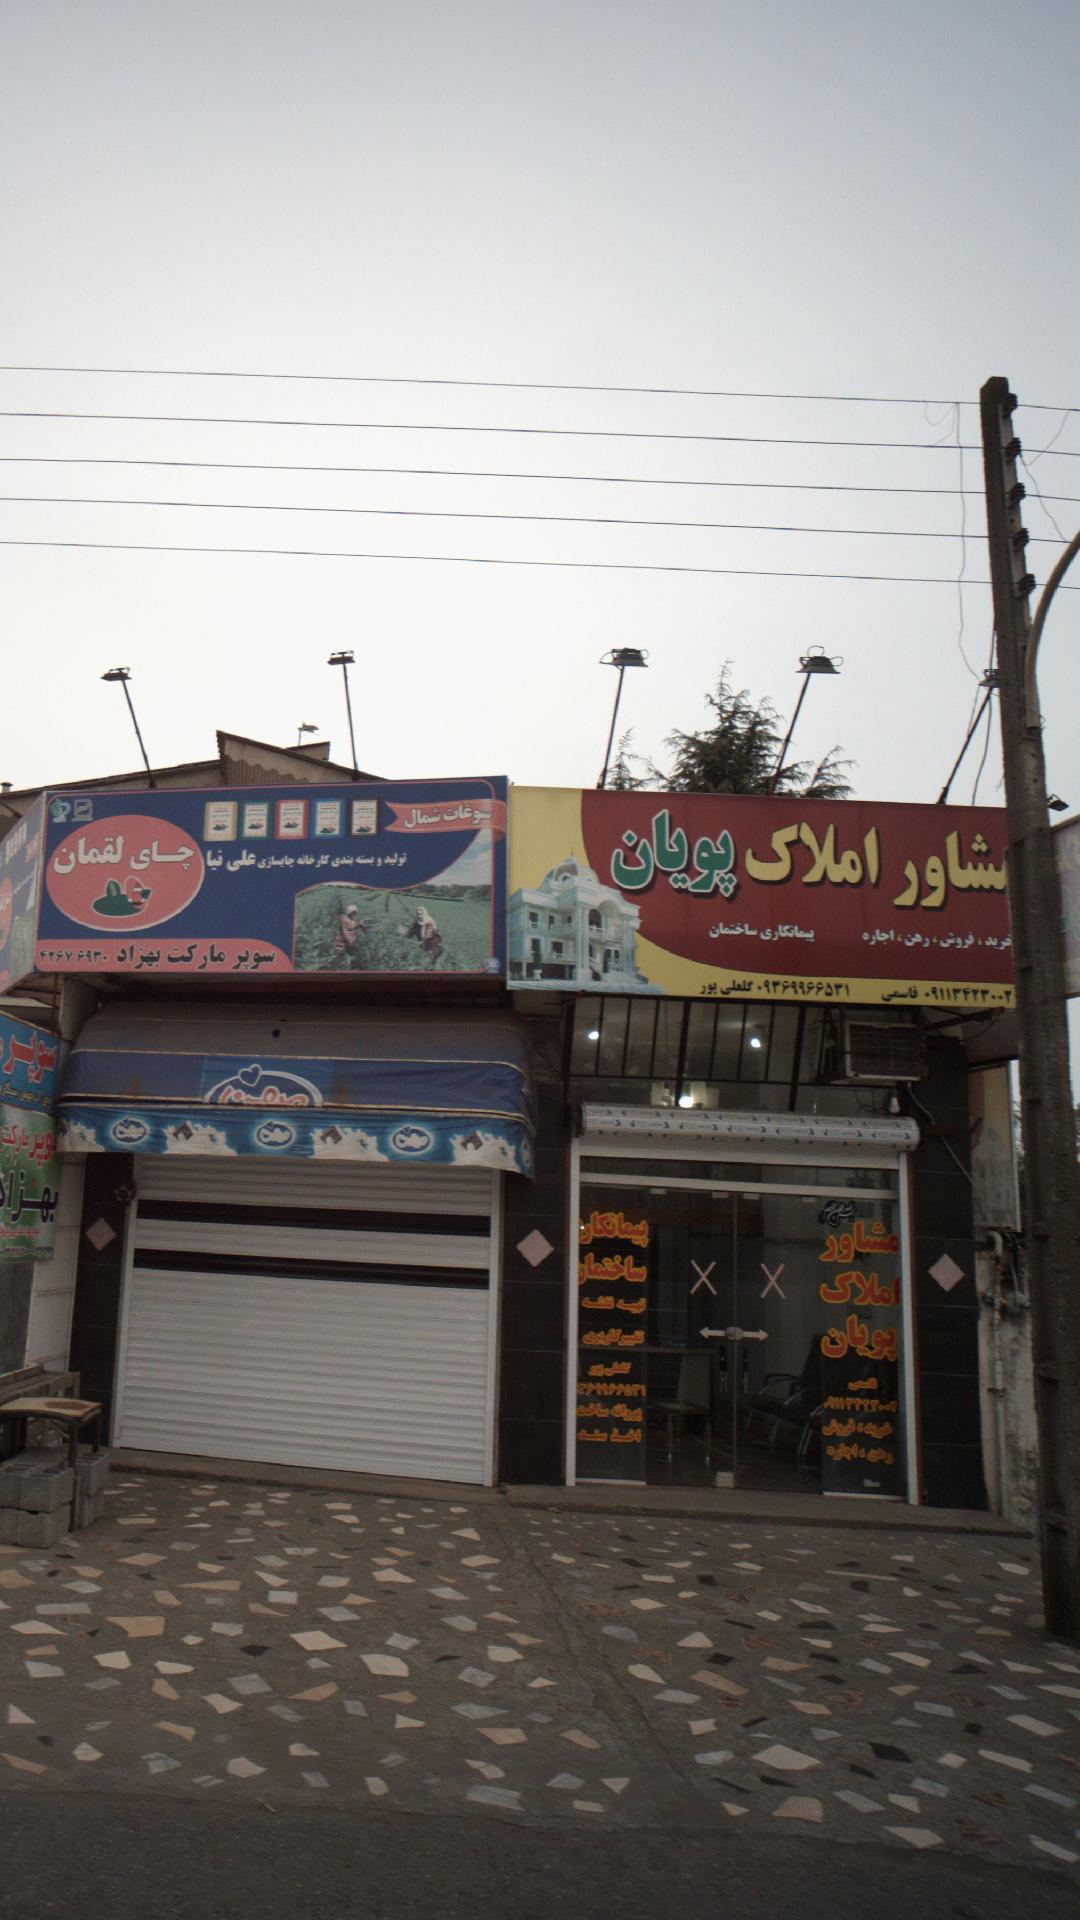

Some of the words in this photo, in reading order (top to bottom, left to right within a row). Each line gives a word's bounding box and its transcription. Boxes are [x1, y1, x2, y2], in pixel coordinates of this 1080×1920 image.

[403, 808, 440, 829] شمال
[443, 804, 491, 823] سوغات
[54, 835, 125, 874] لقمان
[129, 838, 194, 870] چای
[206, 849, 224, 871] نیا
[227, 849, 256, 872] علی
[296, 854, 330, 867] کارخانه
[331, 854, 353, 867] بندی
[355, 854, 374, 865] بسته
[384, 852, 407, 867] تولید
[610, 808, 737, 897] پویان
[745, 822, 879, 885] املاک
[893, 830, 1007, 908] شاور
[709, 922, 757, 938] ساختمان
[760, 924, 815, 942] پیمانکاری
[862, 929, 894, 946] اجاره
[117, 944, 160, 969] بهزاد
[166, 944, 226, 970] مارکت
[232, 949, 276, 970] سوپر
[700, 981, 718, 995] پور
[881, 987, 918, 1002] قاسمی
[2, 1030, 56, 1084] سوپر
[578, 1211, 648, 1248] پیمانکار
[818, 1219, 899, 1263] مشاور
[820, 1271, 900, 1306] املاک
[821, 1313, 897, 1362] پویان
